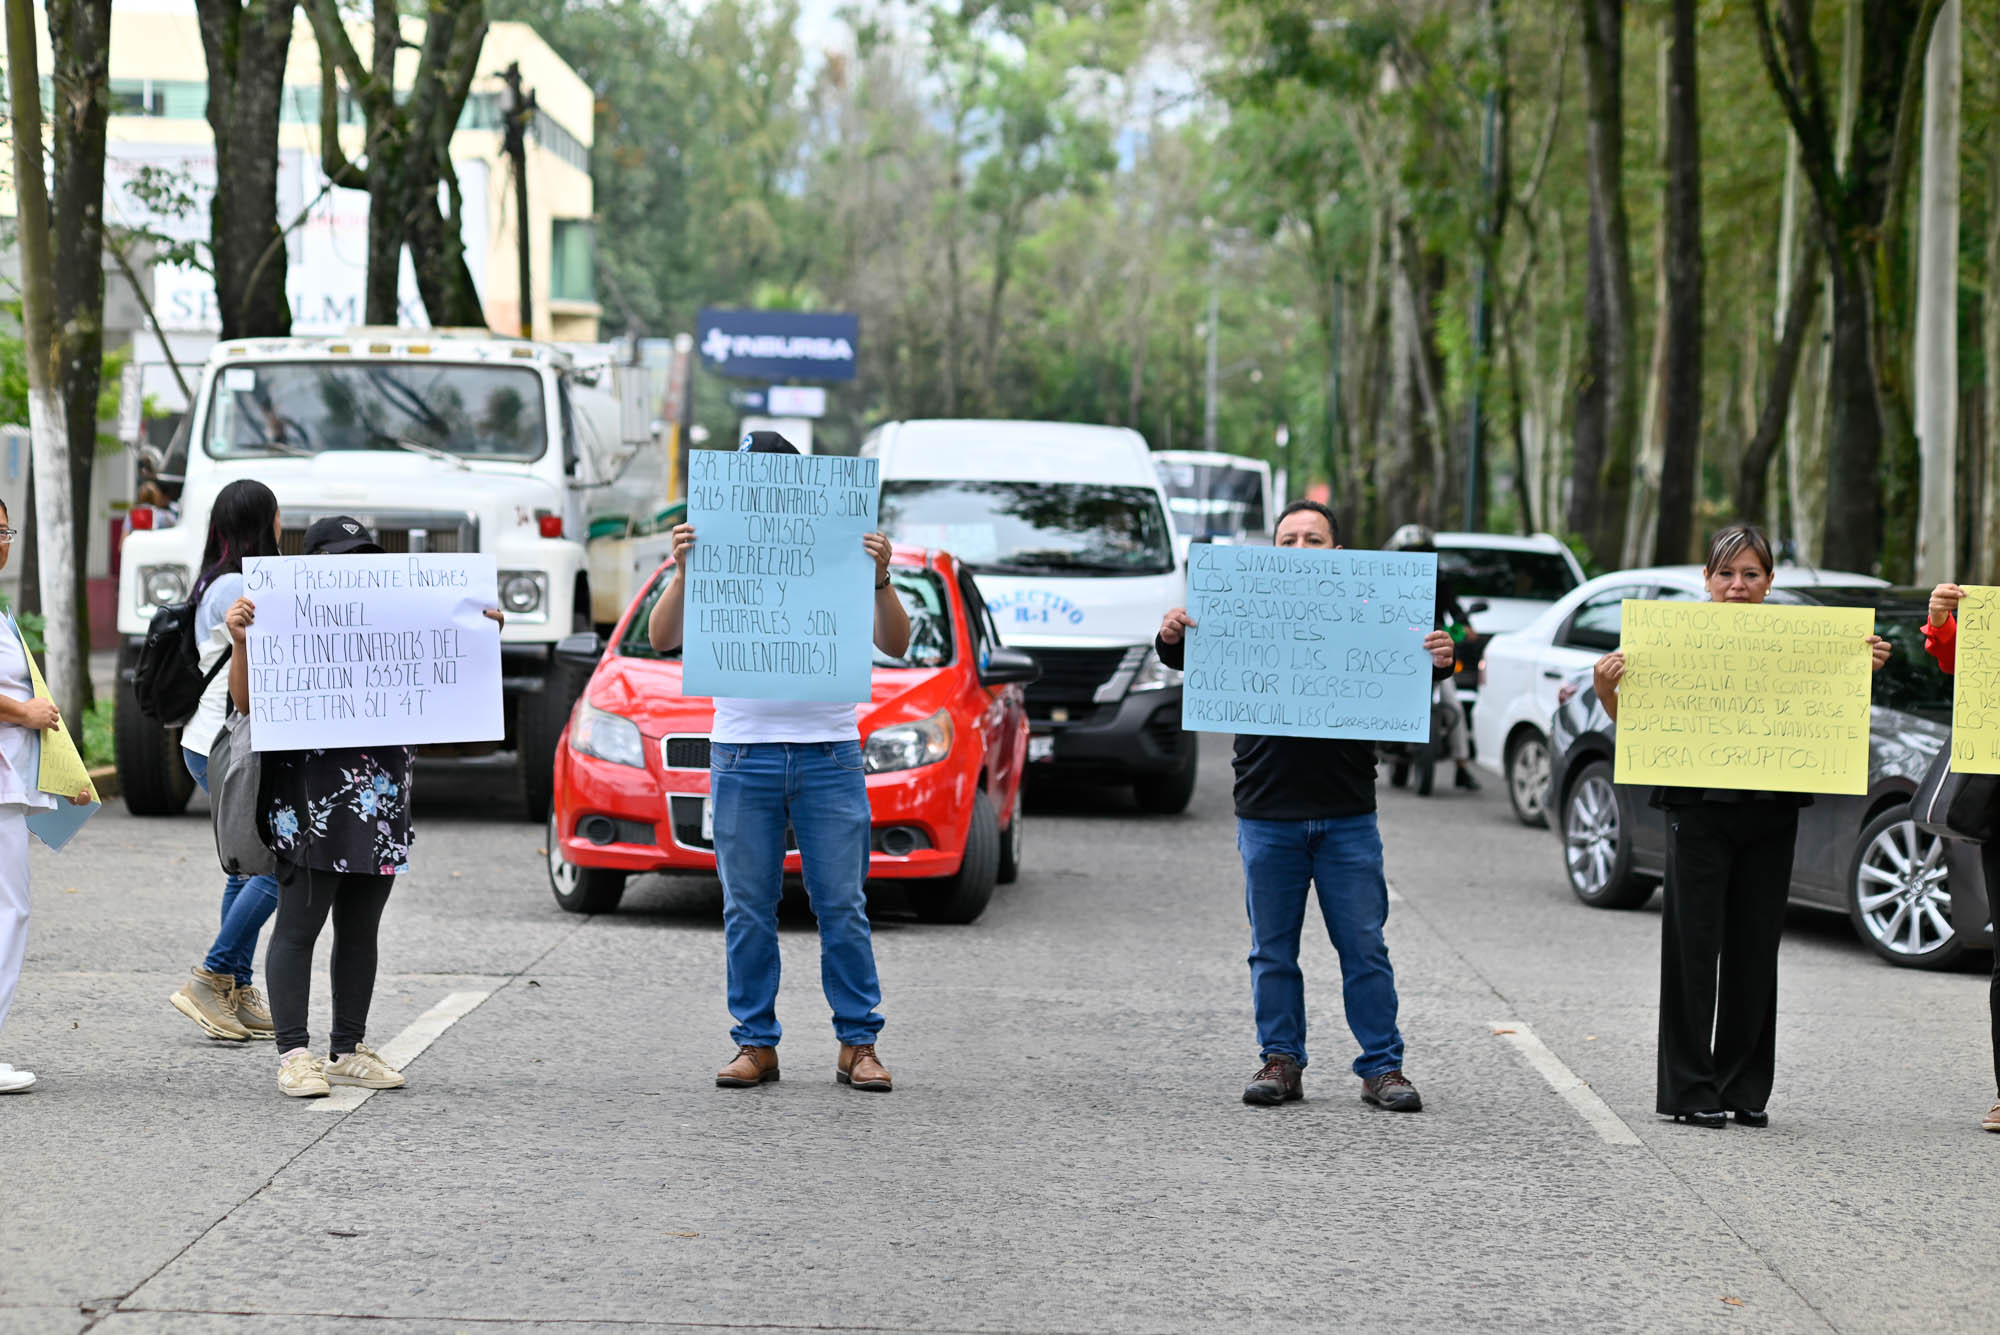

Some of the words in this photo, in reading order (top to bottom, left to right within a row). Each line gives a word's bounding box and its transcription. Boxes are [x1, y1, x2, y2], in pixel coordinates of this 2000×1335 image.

[830, 458, 876, 488] AMLO
[691, 485, 724, 511] SUS
[731, 485, 829, 516] FUNCIONARIOS
[835, 490, 868, 517] SON
[287, 558, 403, 590] PRESIDENTE
[409, 557, 468, 588] ANDRES
[692, 543, 722, 573] LOS
[727, 545, 815, 576] DERECHOS
[1196, 547, 1222, 570] EL
[1235, 550, 1341, 575] SINADISSSTE
[1351, 557, 1434, 576] DEFIENDE
[692, 578, 764, 605] HUMANOS
[777, 580, 787, 607] Y
[1192, 573, 1233, 593] LOS
[1240, 575, 1346, 598] DERECHOS
[1356, 584, 1378, 599] DE
[1398, 584, 1434, 601] LOS
[295, 593, 373, 629] MANUEL
[700, 608, 791, 635] LABORALES
[804, 610, 837, 636] SON
[986, 590, 1084, 625] OLECTIVO
[1196, 595, 1343, 622] TRABAJADORES
[1350, 607, 1367, 624] DE
[1378, 603, 1434, 625] BASE
[1627, 605, 1721, 632] HACEMOS
[1733, 611, 1865, 639] RESPONSABLES
[1965, 612, 1993, 631] EN
[250, 634, 283, 664] LOS
[292, 630, 424, 664] FUNCIONARIOS
[430, 628, 467, 660] DEL
[1624, 633, 1638, 646] A
[1646, 632, 1671, 648] LAS
[1683, 632, 1782, 653] AUTORIDADES
[1290, 648, 1327, 671] LAS
[1345, 648, 1417, 676] BASES
[1626, 653, 1658, 669] DEL
[1672, 653, 1736, 673] ISSSTE
[1751, 656, 1768, 673] DE
[1777, 656, 1867, 677] CUALQUIER
[251, 665, 353, 694] DELEGACION
[366, 663, 424, 688] ISSSTE
[433, 661, 457, 685] NO
[1188, 668, 1236, 692] QUE
[1241, 670, 1279, 695] POR
[1292, 673, 1383, 699] DECRETO
[1844, 681, 1866, 698] DE
[253, 694, 355, 723] RESPETAN
[364, 691, 387, 718] SU
[1187, 698, 1292, 725] PRESIDENCIAL
[1298, 705, 1321, 728] LES
[1620, 693, 1654, 710] LOS
[1663, 694, 1765, 714] AGREMIADOS
[1776, 699, 1793, 716] DE
[1804, 700, 1846, 718] BASE
[1857, 702, 1869, 720] Y
[1956, 690, 1969, 708] A
[1622, 714, 1732, 735] SUPLENTES
[1623, 744, 1694, 771] FUERA
[1953, 739, 1975, 760] NO
